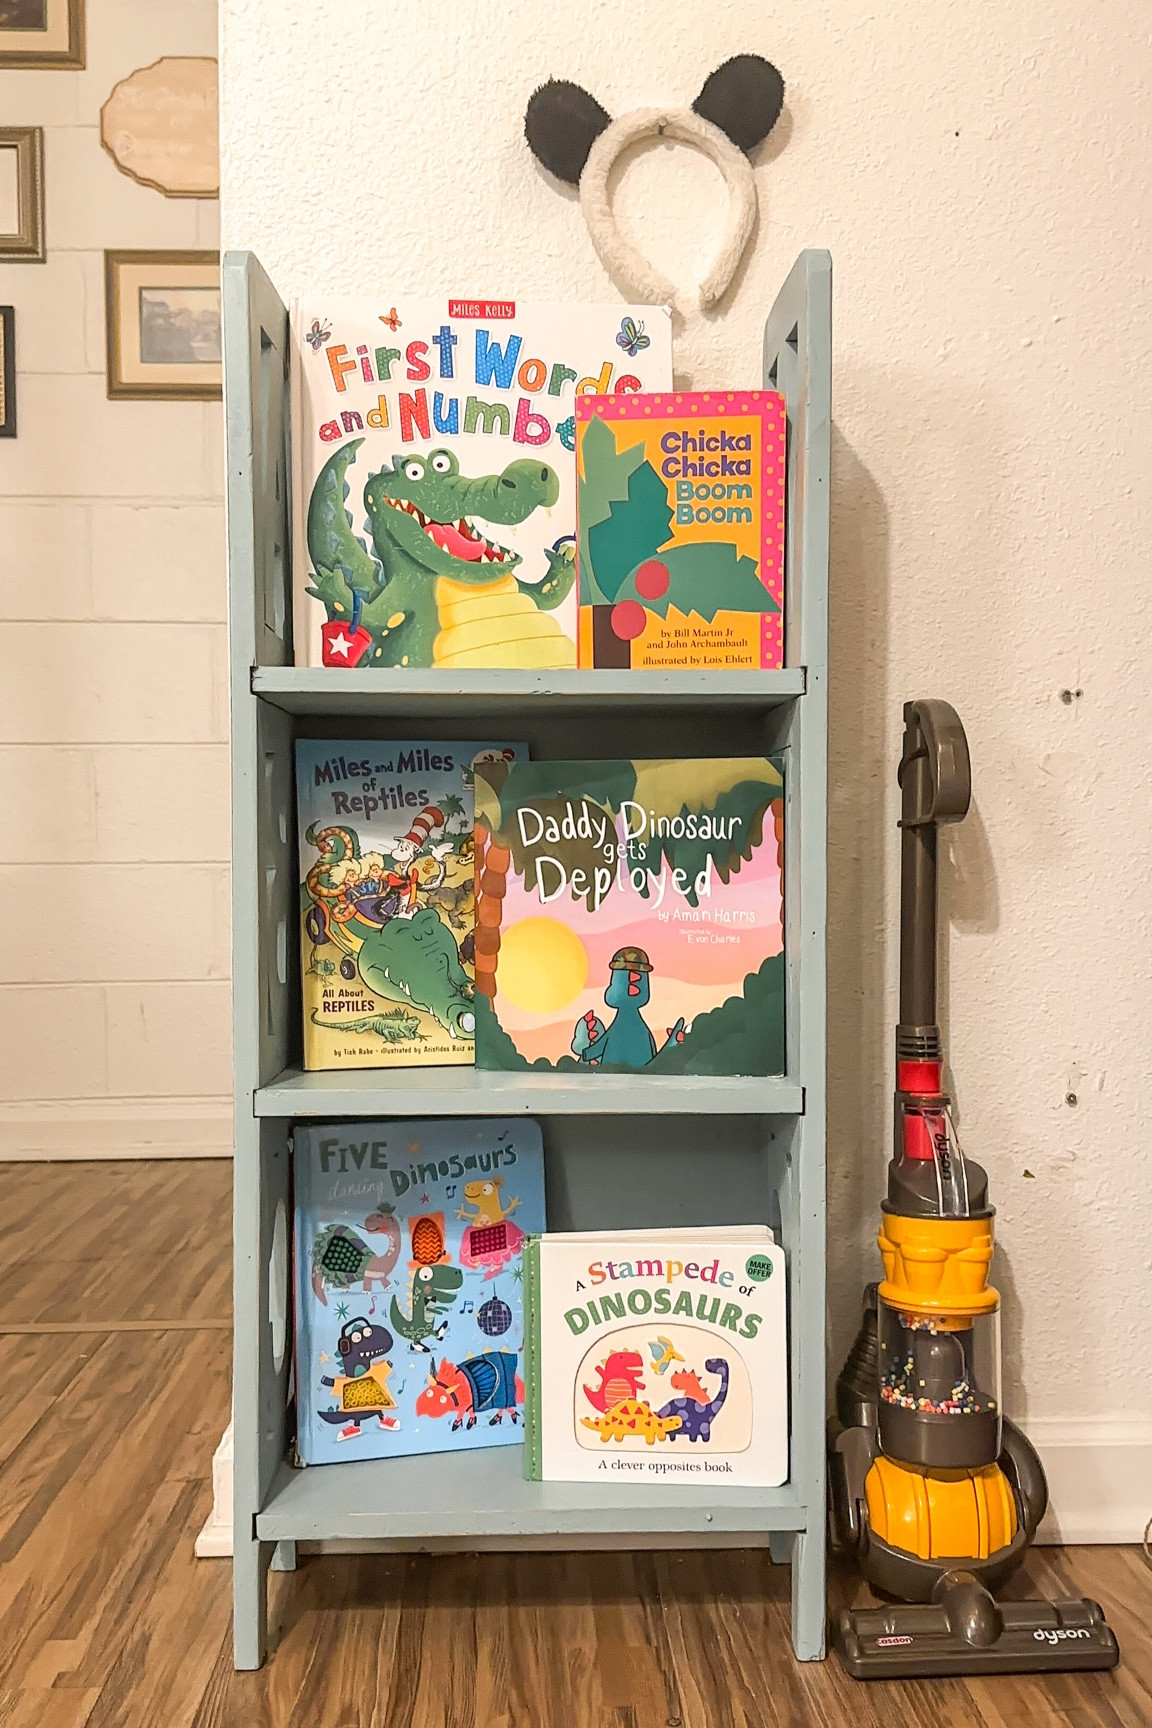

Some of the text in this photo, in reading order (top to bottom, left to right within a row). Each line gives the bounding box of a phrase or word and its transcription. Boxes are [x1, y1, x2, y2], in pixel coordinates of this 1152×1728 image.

[325, 325, 458, 393] First
[319, 395, 388, 442] and
[661, 430, 751, 453] Chicka
[661, 455, 751, 478] Chicka
[676, 481, 752, 501] Boom
[676, 503, 752, 525] Boom
[646, 638, 748, 649] and John Archambault
[661, 628, 734, 639] by Bill Martin Jr
[643, 655, 752, 665] illustrated by Lois Ehlert
[314, 749, 454, 786] Miles and Miles
[362, 778, 377, 793] of
[331, 784, 430, 821] Reptiles
[517, 801, 742, 849] Daddy Dinosaur
[603, 841, 647, 864] gets
[535, 853, 713, 911] Deployed
[658, 907, 756, 922] by Amari Harris
[322, 988, 364, 998] All About
[323, 1000, 375, 1013] REPTILES
[334, 1049, 342, 1057] by
[414, 1046, 421, 1054] by
[319, 1138, 388, 1173] FIVE
[935, 1133, 950, 1180] dyson
[328, 1144, 517, 1203] dancing Dinosaurs
[747, 1267, 771, 1278] OFFER
[749, 1260, 771, 1271] MAKE
[576, 1259, 756, 1297] A Stampede of
[564, 1288, 763, 1339] DINOSAURS
[598, 1460, 733, 1473] A clever opposites book
[1033, 1627, 1091, 1645] dyson
